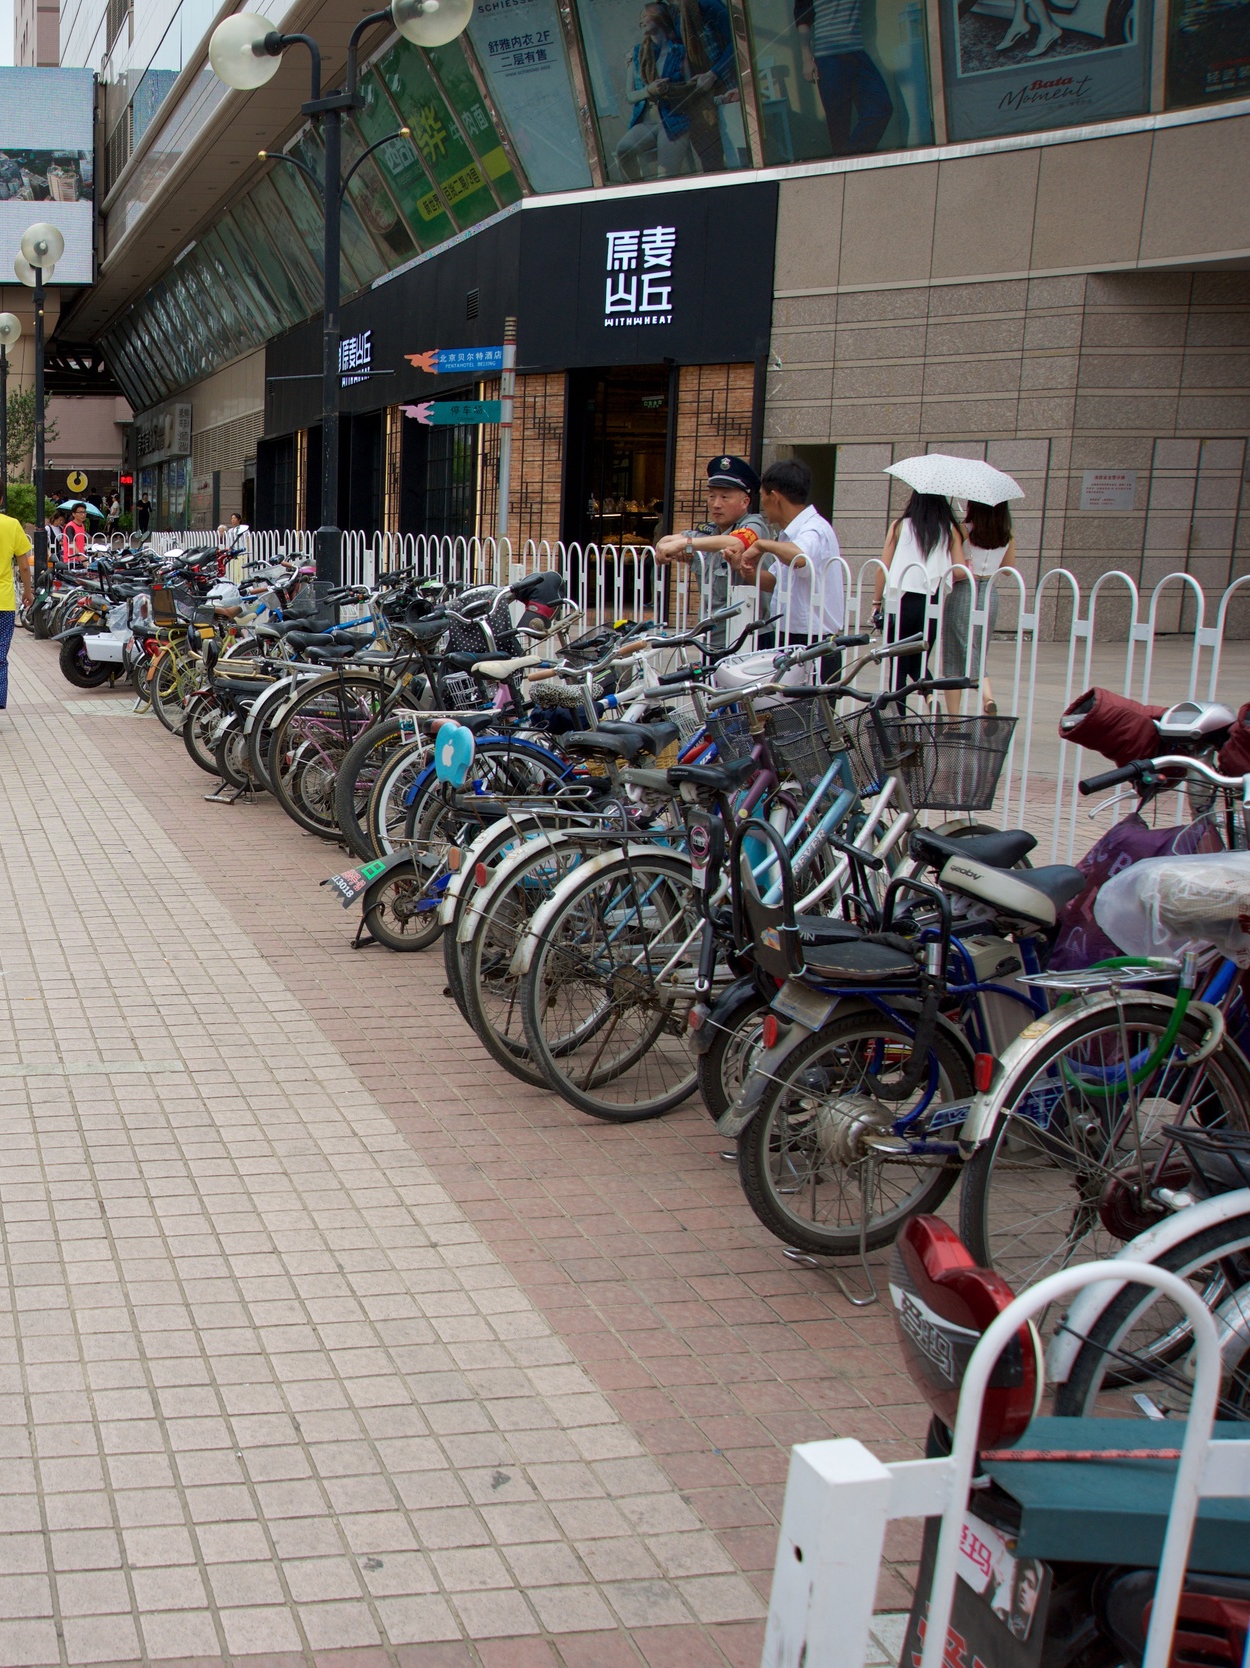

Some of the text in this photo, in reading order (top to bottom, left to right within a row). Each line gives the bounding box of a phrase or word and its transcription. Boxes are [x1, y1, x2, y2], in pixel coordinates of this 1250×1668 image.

[488, 30, 550, 53] 舒雅内衣 2F
[501, 49, 547, 68] 二层有售
[998, 76, 1092, 111] Moment
[1028, 77, 1073, 91] Bata
[606, 226, 676, 270] 原麦
[605, 270, 672, 314] 山丘
[605, 315, 672, 327] WITHWHEAT
[439, 350, 502, 363] 北京贝尔特酒店
[451, 404, 483, 416] 停车场
